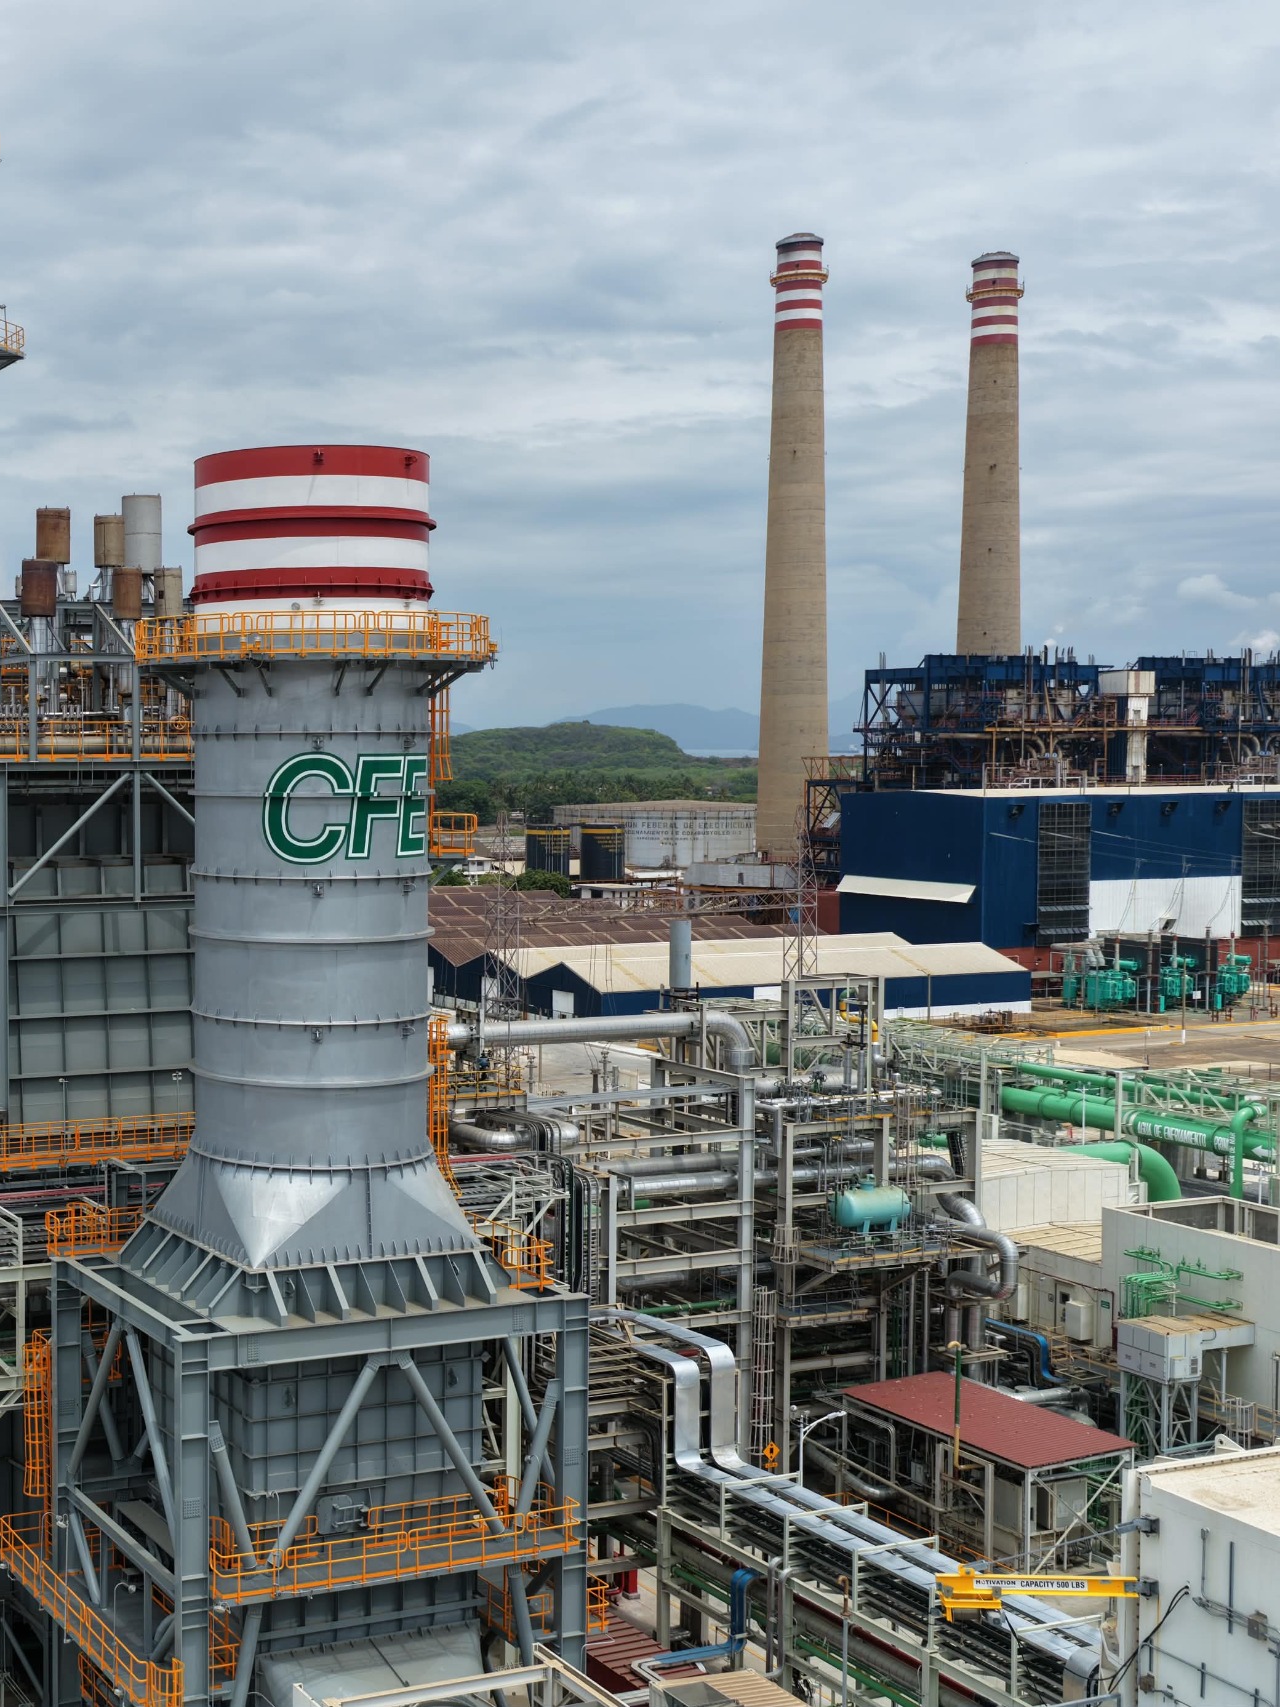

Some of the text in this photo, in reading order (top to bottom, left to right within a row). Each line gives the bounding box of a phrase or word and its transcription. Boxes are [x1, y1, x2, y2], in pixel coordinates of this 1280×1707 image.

[262, 751, 428, 865] CFE
[641, 821, 679, 829] FEDERAL
[1137, 1121, 1151, 1134] AGUA
[1153, 1124, 1163, 1138] DE
[1020, 1580, 1055, 1588] CAPACITY
[1071, 1581, 1085, 1589] LBS
